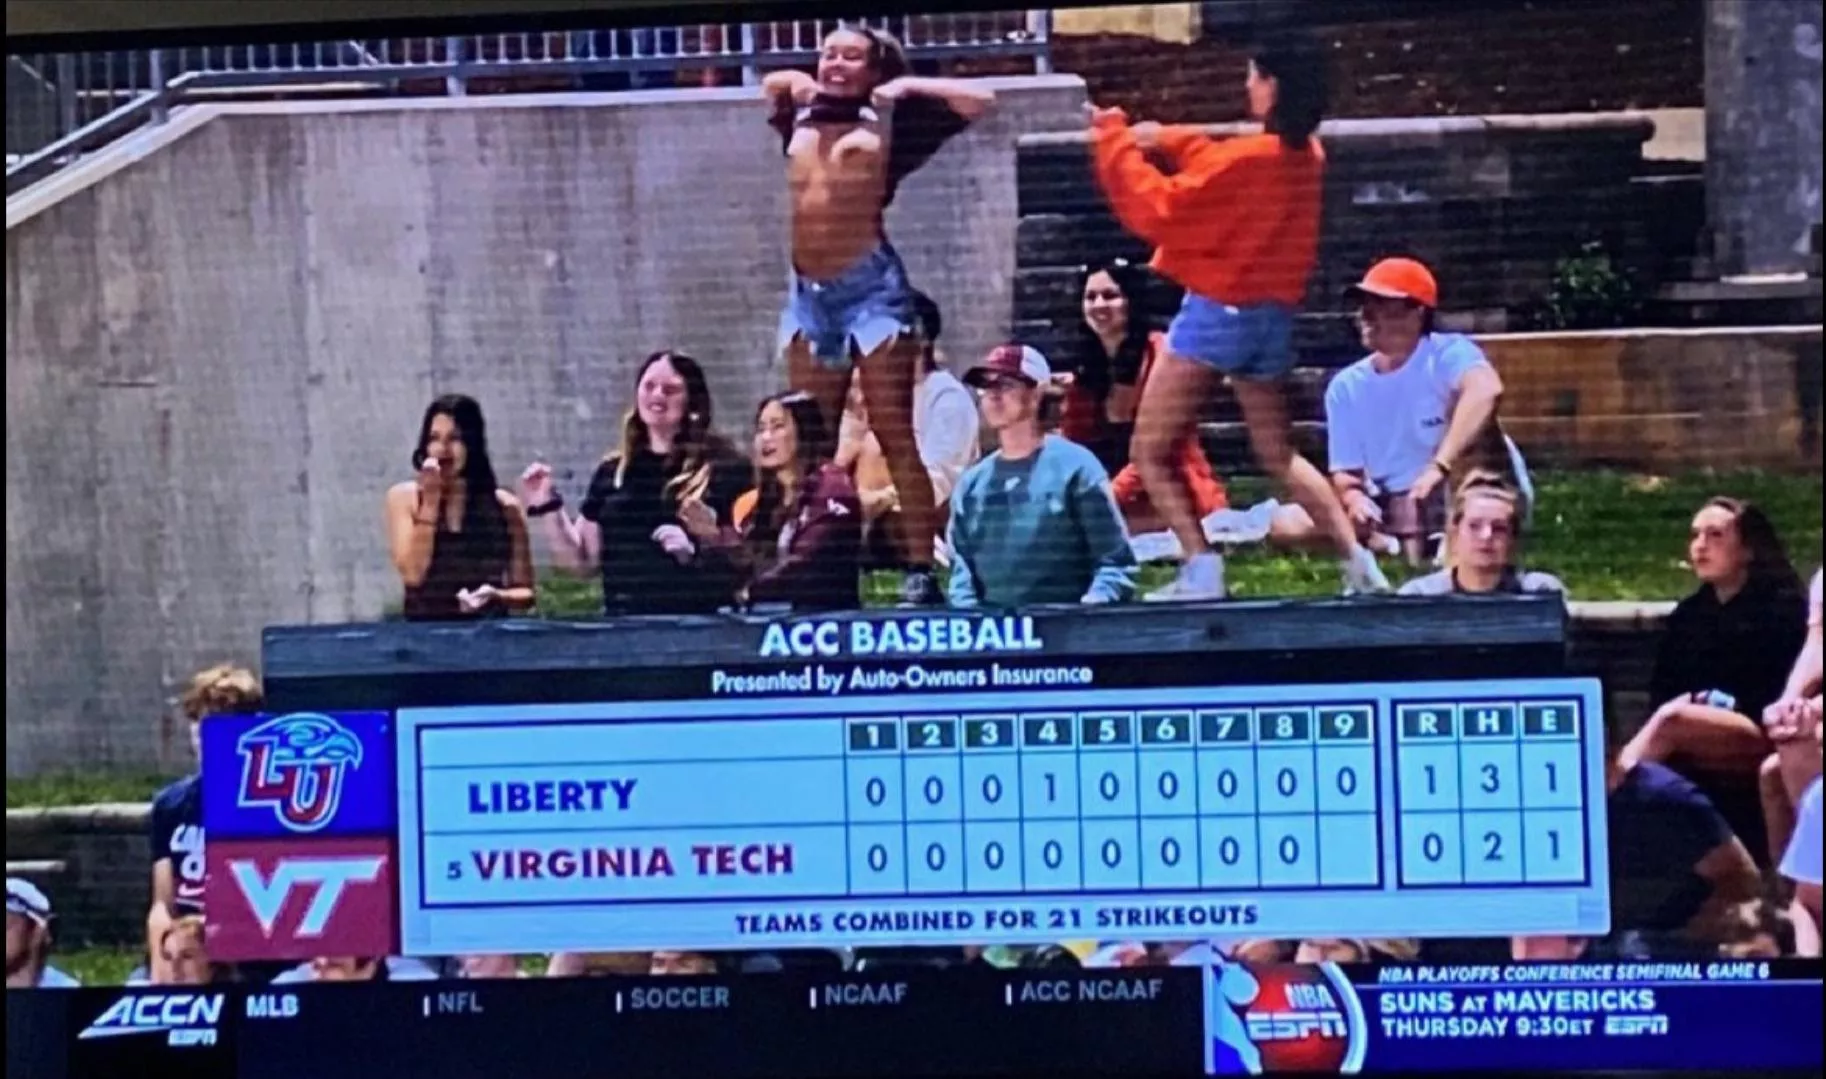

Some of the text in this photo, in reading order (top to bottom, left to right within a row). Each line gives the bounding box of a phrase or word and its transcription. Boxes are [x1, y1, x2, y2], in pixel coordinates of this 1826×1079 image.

[760, 616, 1043, 656] ACC BASEBALL
[712, 663, 1093, 694] Presented by Auto-Owners Insurance
[867, 709, 1556, 747] 1 2 3 4 5 6 7 8 9 R H E
[468, 762, 1556, 814] LIBERTY 0 0 0 1 0 0 0 0 0 1 3 1
[446, 830, 1559, 881] 5 VIRGINIA TECH 0 0 0 0 0 0 0 0 0 2 1
[229, 854, 388, 939] VT
[735, 905, 1259, 934] TEAMS COMBINED FOR 21 STRIKEOUTS
[1379, 967, 1413, 982] NBA
[1417, 966, 1500, 981] PLAYOFFS
[1504, 964, 1614, 981] CONFERENCE
[1616, 963, 1702, 980] SEMIFINAL
[1707, 963, 1755, 979] GAME
[630, 986, 730, 1008] SOCCER
[824, 983, 908, 1005] NCAAF
[1020, 979, 1163, 1002] ACC NCAAF
[1284, 984, 1336, 1008] NBA
[1380, 989, 1656, 1013] SUNS AT MAVERICKS
[93, 994, 225, 1025] ACCN
[246, 995, 300, 1017] MLB
[437, 992, 484, 1014] NFL
[168, 1029, 217, 1045] ESPN
[1245, 1012, 1347, 1040] ESPN
[1381, 1015, 1668, 1037] THURSDAY 9:30ET ESPN
